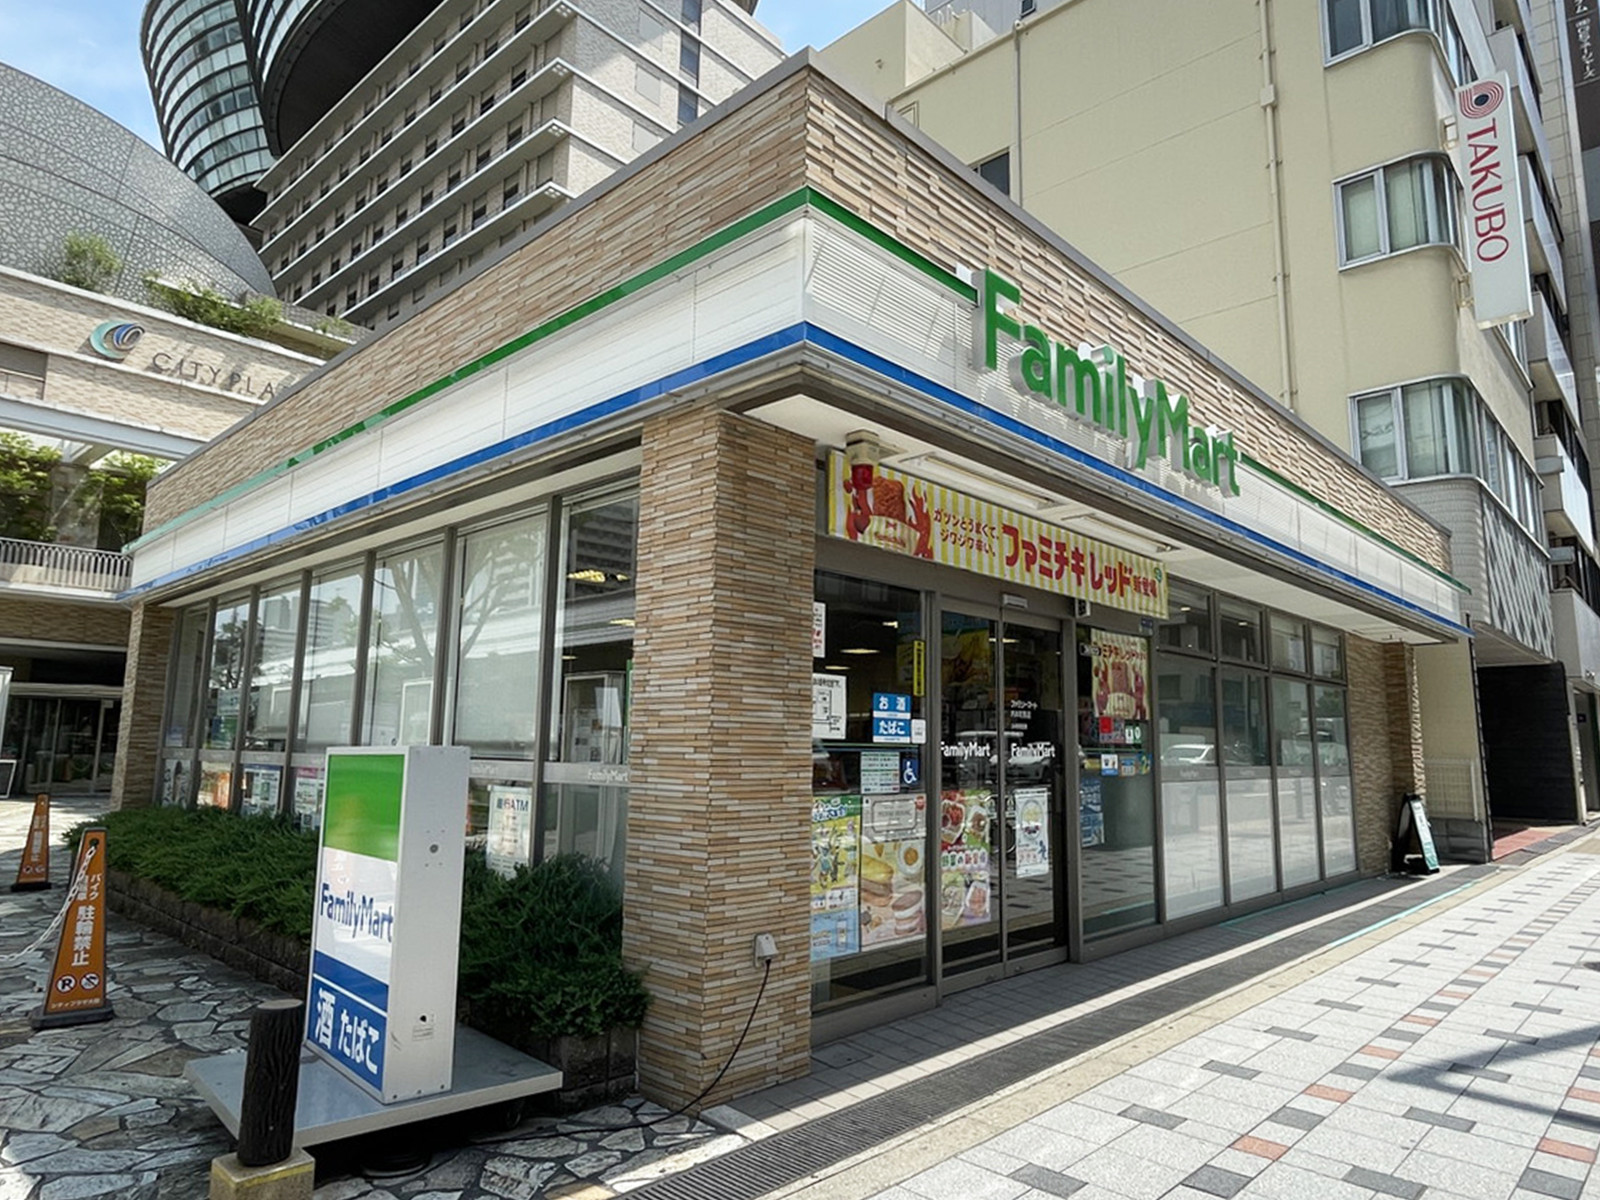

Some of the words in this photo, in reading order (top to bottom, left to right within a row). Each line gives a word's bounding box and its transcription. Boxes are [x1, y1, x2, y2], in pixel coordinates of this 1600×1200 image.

[1467, 118, 1509, 262] TAKUBO
[152, 352, 221, 384] CITY
[230, 371, 288, 400] PLA
[972, 266, 1240, 497] FamilyMart
[879, 720, 906, 735] たばこ
[1010, 743, 1056, 759] FamilyMart
[90, 873, 102, 900] バイク
[320, 883, 394, 942] FamilyMart
[71, 905, 96, 967] 駐輪禁止
[315, 987, 336, 1050] 酒
[338, 1009, 381, 1075] たばこ
